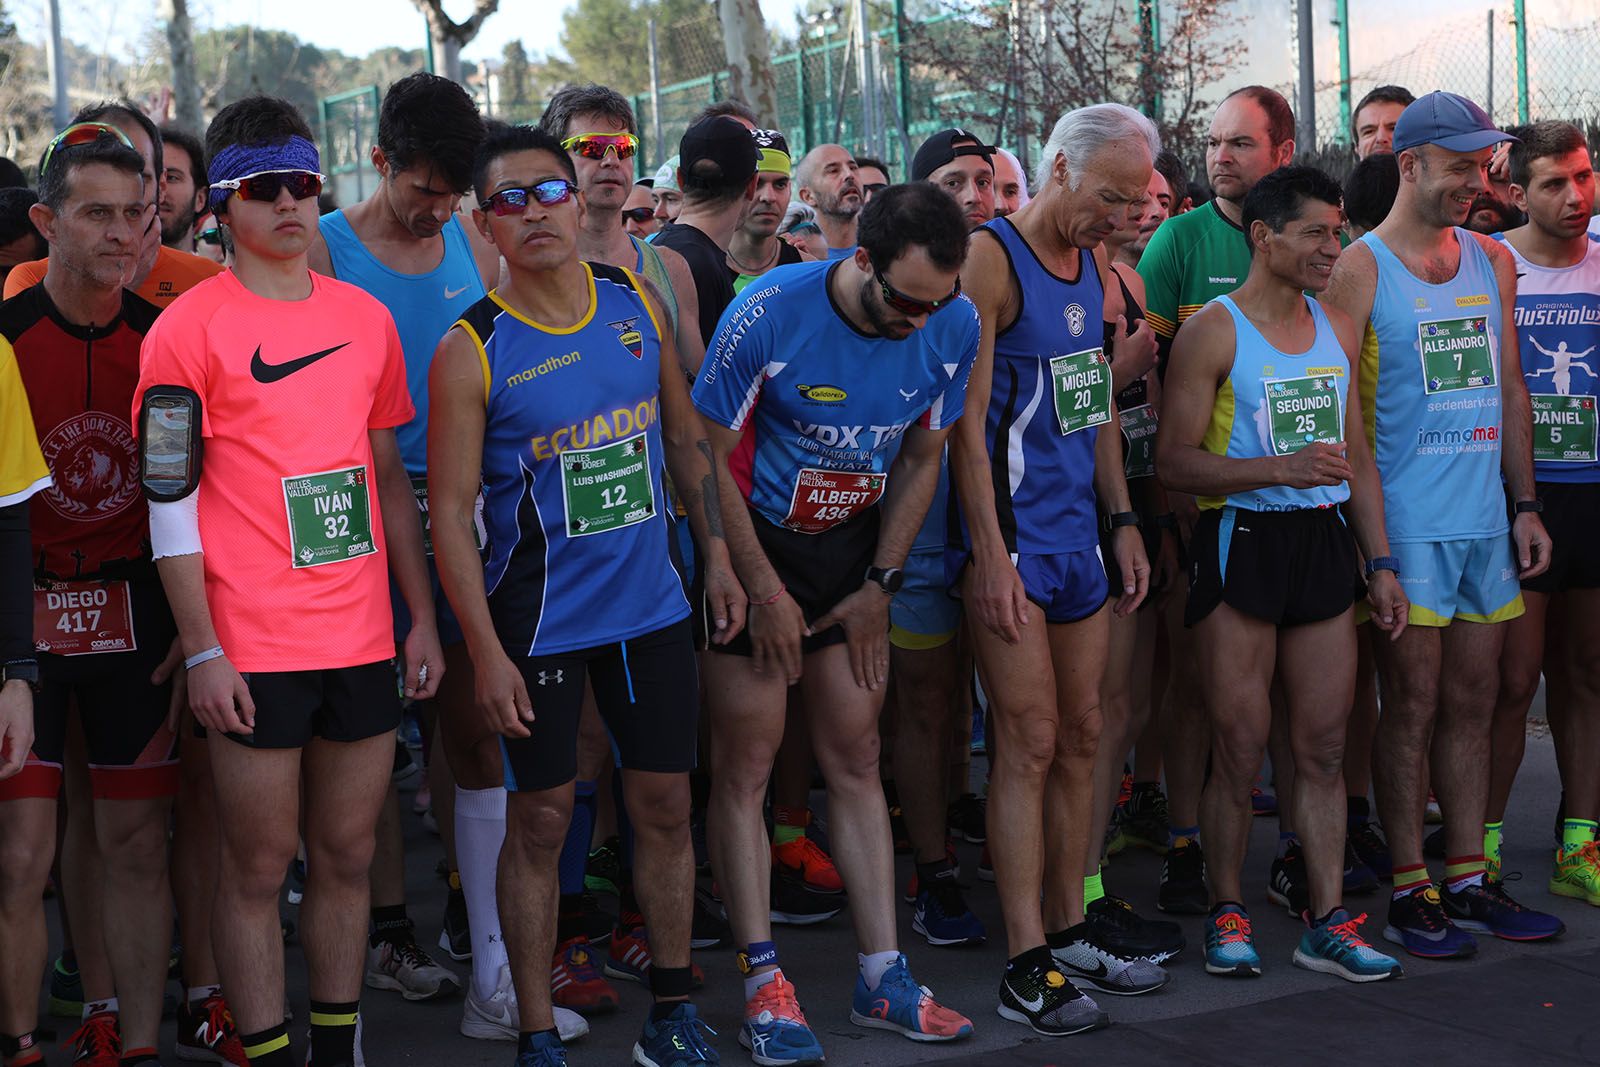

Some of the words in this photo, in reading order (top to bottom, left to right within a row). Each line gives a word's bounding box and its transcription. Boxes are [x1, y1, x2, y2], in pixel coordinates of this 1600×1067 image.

[731, 284, 782, 325] VALLDOREIX
[1424, 335, 1486, 354] ALEJANDRO
[506, 351, 582, 388] marathon
[1453, 353, 1463, 372] 7
[1062, 369, 1104, 392] MIGUEL
[1074, 389, 1092, 410] 20
[1276, 394, 1332, 414] SEGUNDO
[1295, 414, 1316, 434] 25
[1532, 410, 1584, 425] DANIEL
[58, 426, 82, 441] THE
[82, 418, 113, 434] LIONS
[113, 426, 138, 456] TEAM
[531, 396, 658, 462] ECUADOR
[792, 418, 864, 449] VDX
[1550, 426, 1562, 444] 5
[797, 436, 819, 452] CLUB
[1143, 440, 1150, 459] 8
[1416, 445, 1454, 456] SERVEIS
[564, 454, 590, 464] MILLES
[565, 458, 606, 470] VADOREIX
[572, 476, 594, 486] LUIS
[594, 462, 643, 483] WASHINGTON
[801, 479, 836, 488] VALLDOREIX
[802, 472, 824, 480] MILLES
[286, 480, 312, 490] MILLES
[288, 484, 328, 498] VALLDOREIX
[314, 490, 352, 515] IVÁN
[600, 484, 628, 509] 12
[806, 489, 870, 504] ALBERT
[814, 506, 852, 520] 436
[324, 514, 350, 538] 32
[46, 588, 108, 610] DIEGO
[56, 610, 102, 634] 417
[90, 638, 126, 648] COMPLEX
